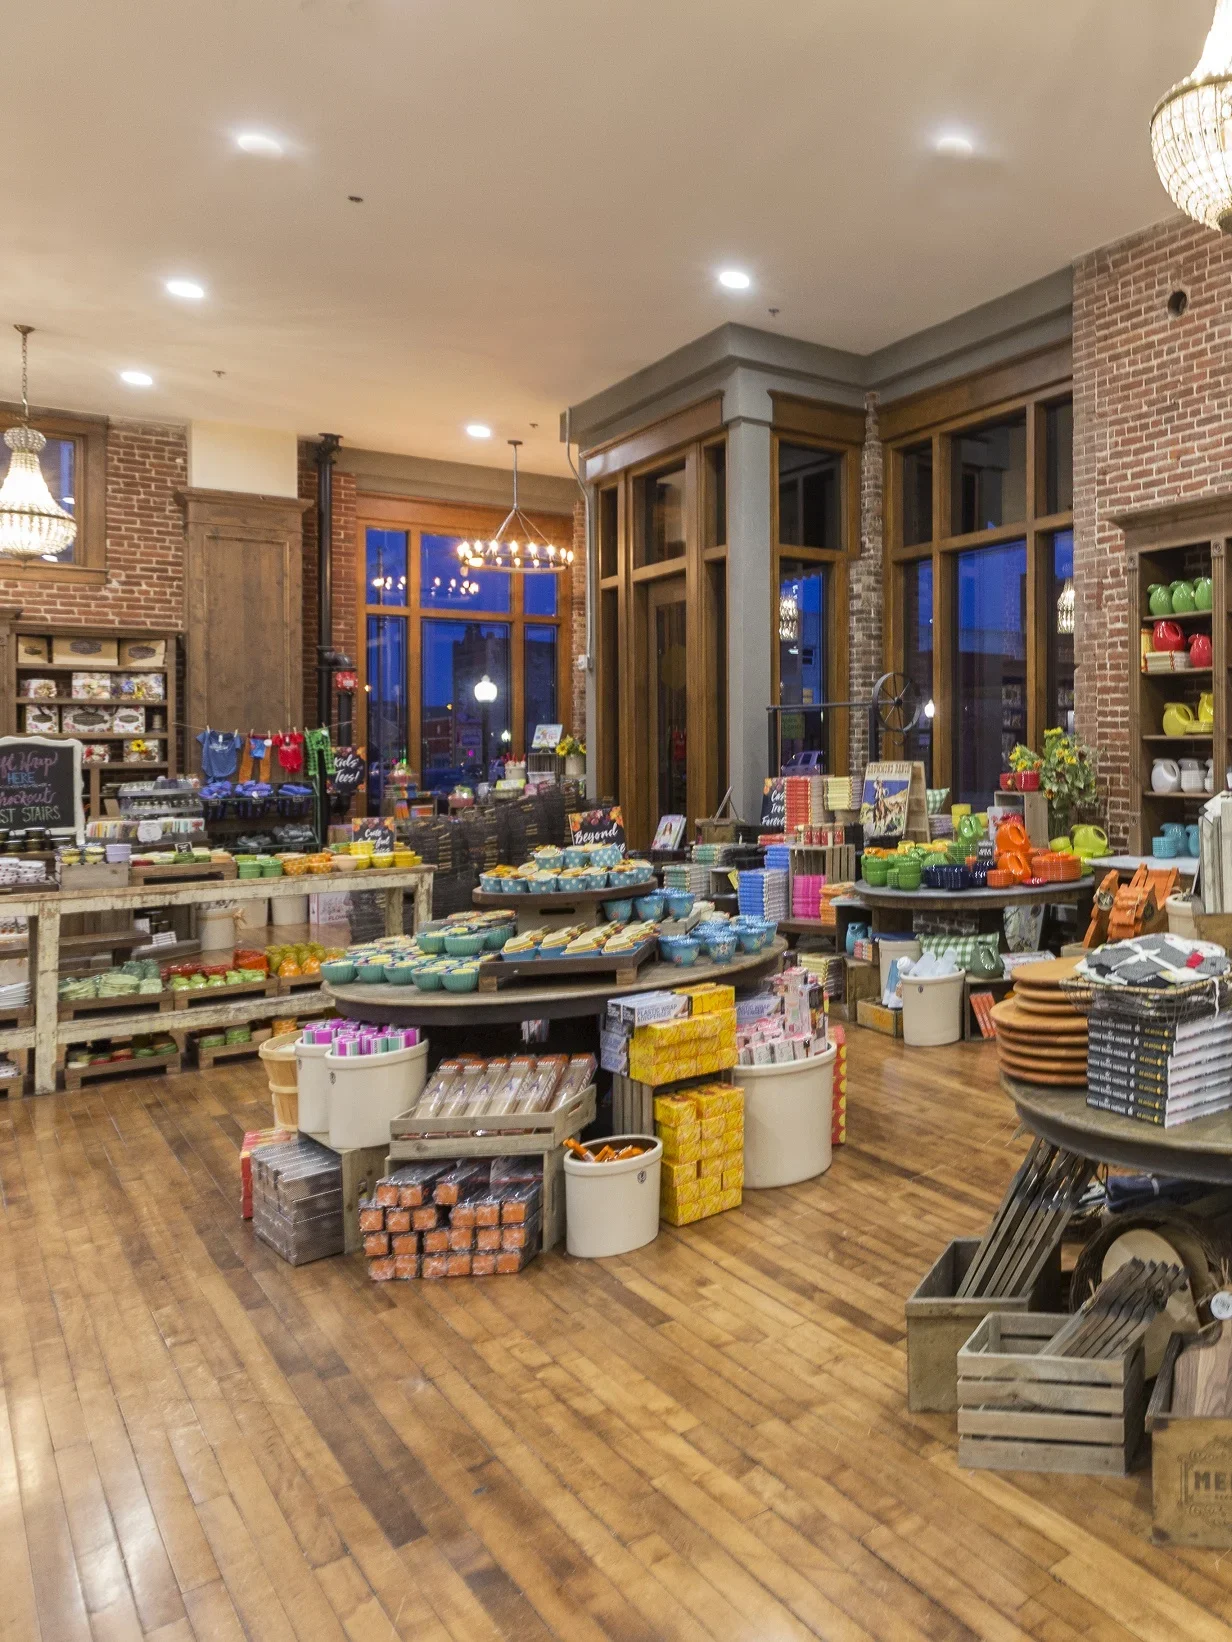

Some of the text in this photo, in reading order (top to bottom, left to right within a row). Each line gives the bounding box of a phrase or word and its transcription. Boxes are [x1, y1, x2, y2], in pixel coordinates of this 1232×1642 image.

[0, 750, 58, 779] ft Wrap
[7, 771, 36, 784] HERE
[334, 768, 360, 783] Tees!
[0, 787, 56, 807] heckout
[771, 789, 785, 802] Cas
[0, 805, 61, 823] ST STAIRS
[762, 815, 785, 826] Foreve
[574, 822, 619, 845] Beyond
